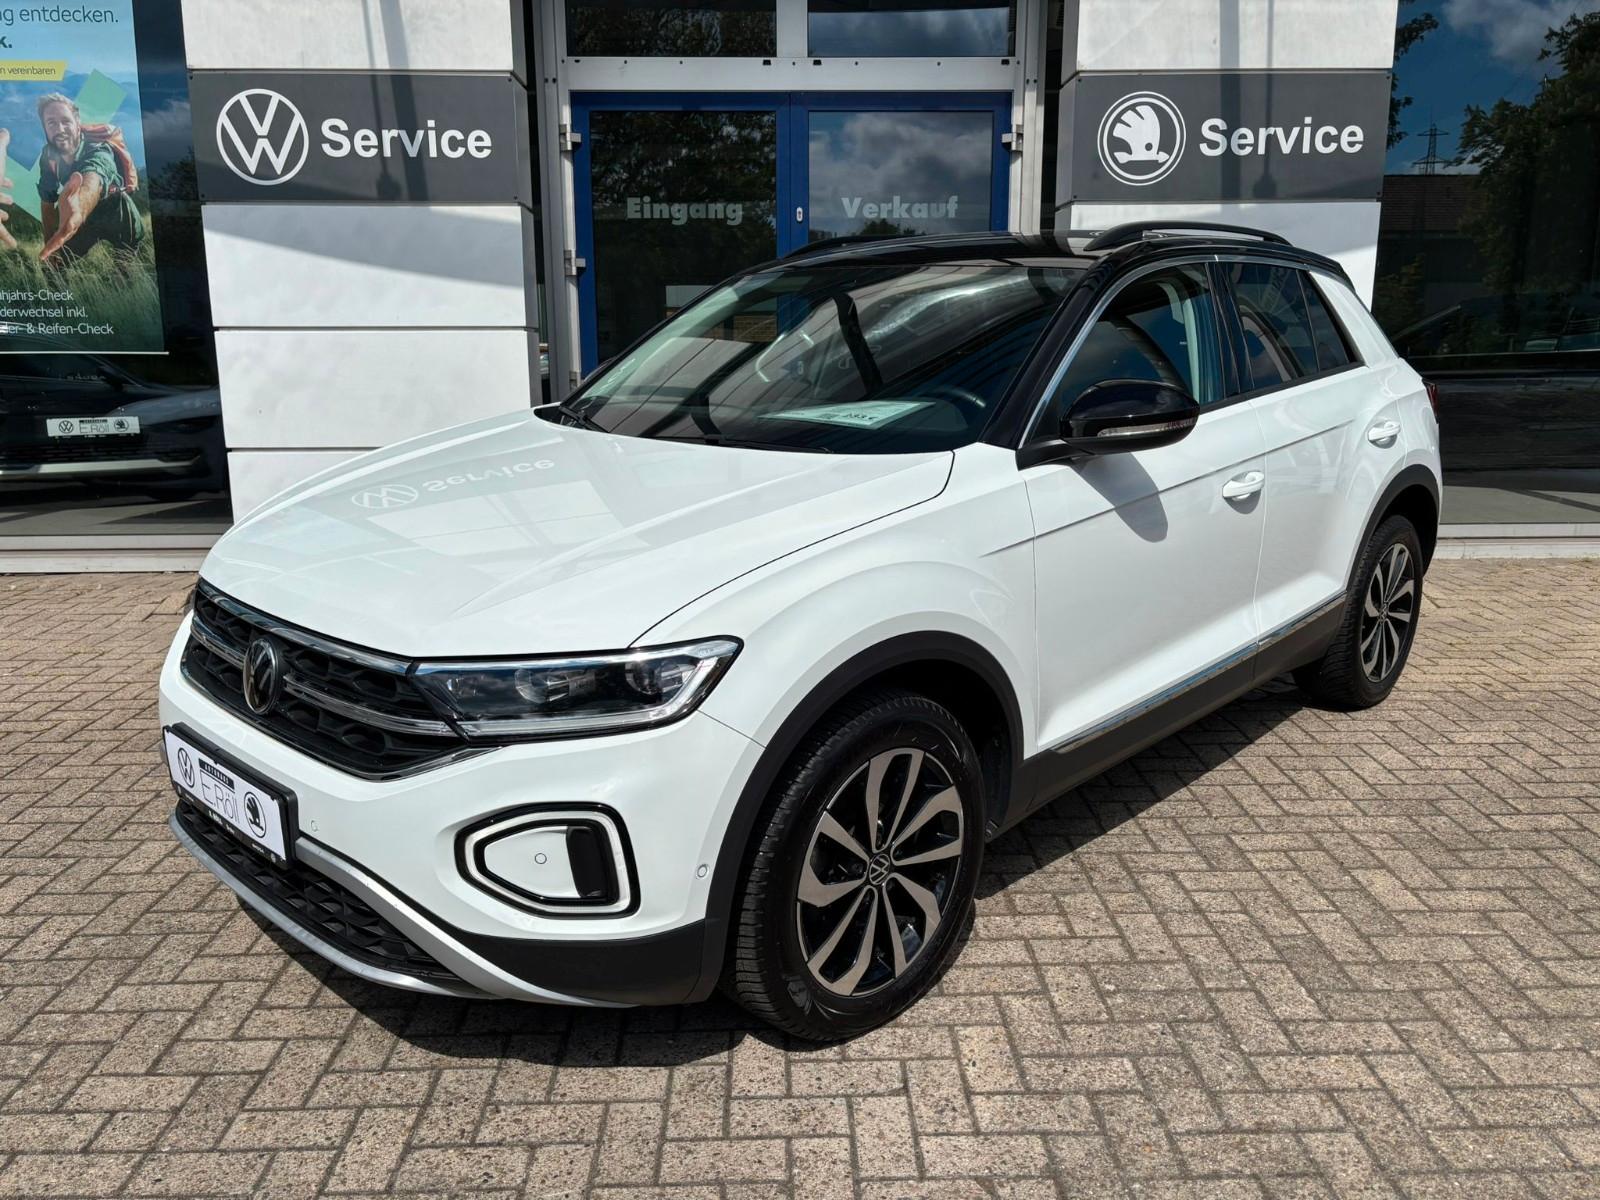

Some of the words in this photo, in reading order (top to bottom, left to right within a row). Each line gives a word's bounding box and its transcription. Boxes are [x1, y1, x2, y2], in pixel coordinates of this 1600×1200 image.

[19, 5, 119, 23] entdecken.
[8, 66, 56, 75] vereinbaren
[320, 117, 492, 159] Service
[1199, 116, 1364, 157] Service
[626, 196, 743, 226] Eingang
[841, 195, 959, 220] Verkauf
[0, 289, 74, 303] hjahrs-Check
[26, 322, 35, 334] &
[38, 323, 114, 334] Reifen-Check
